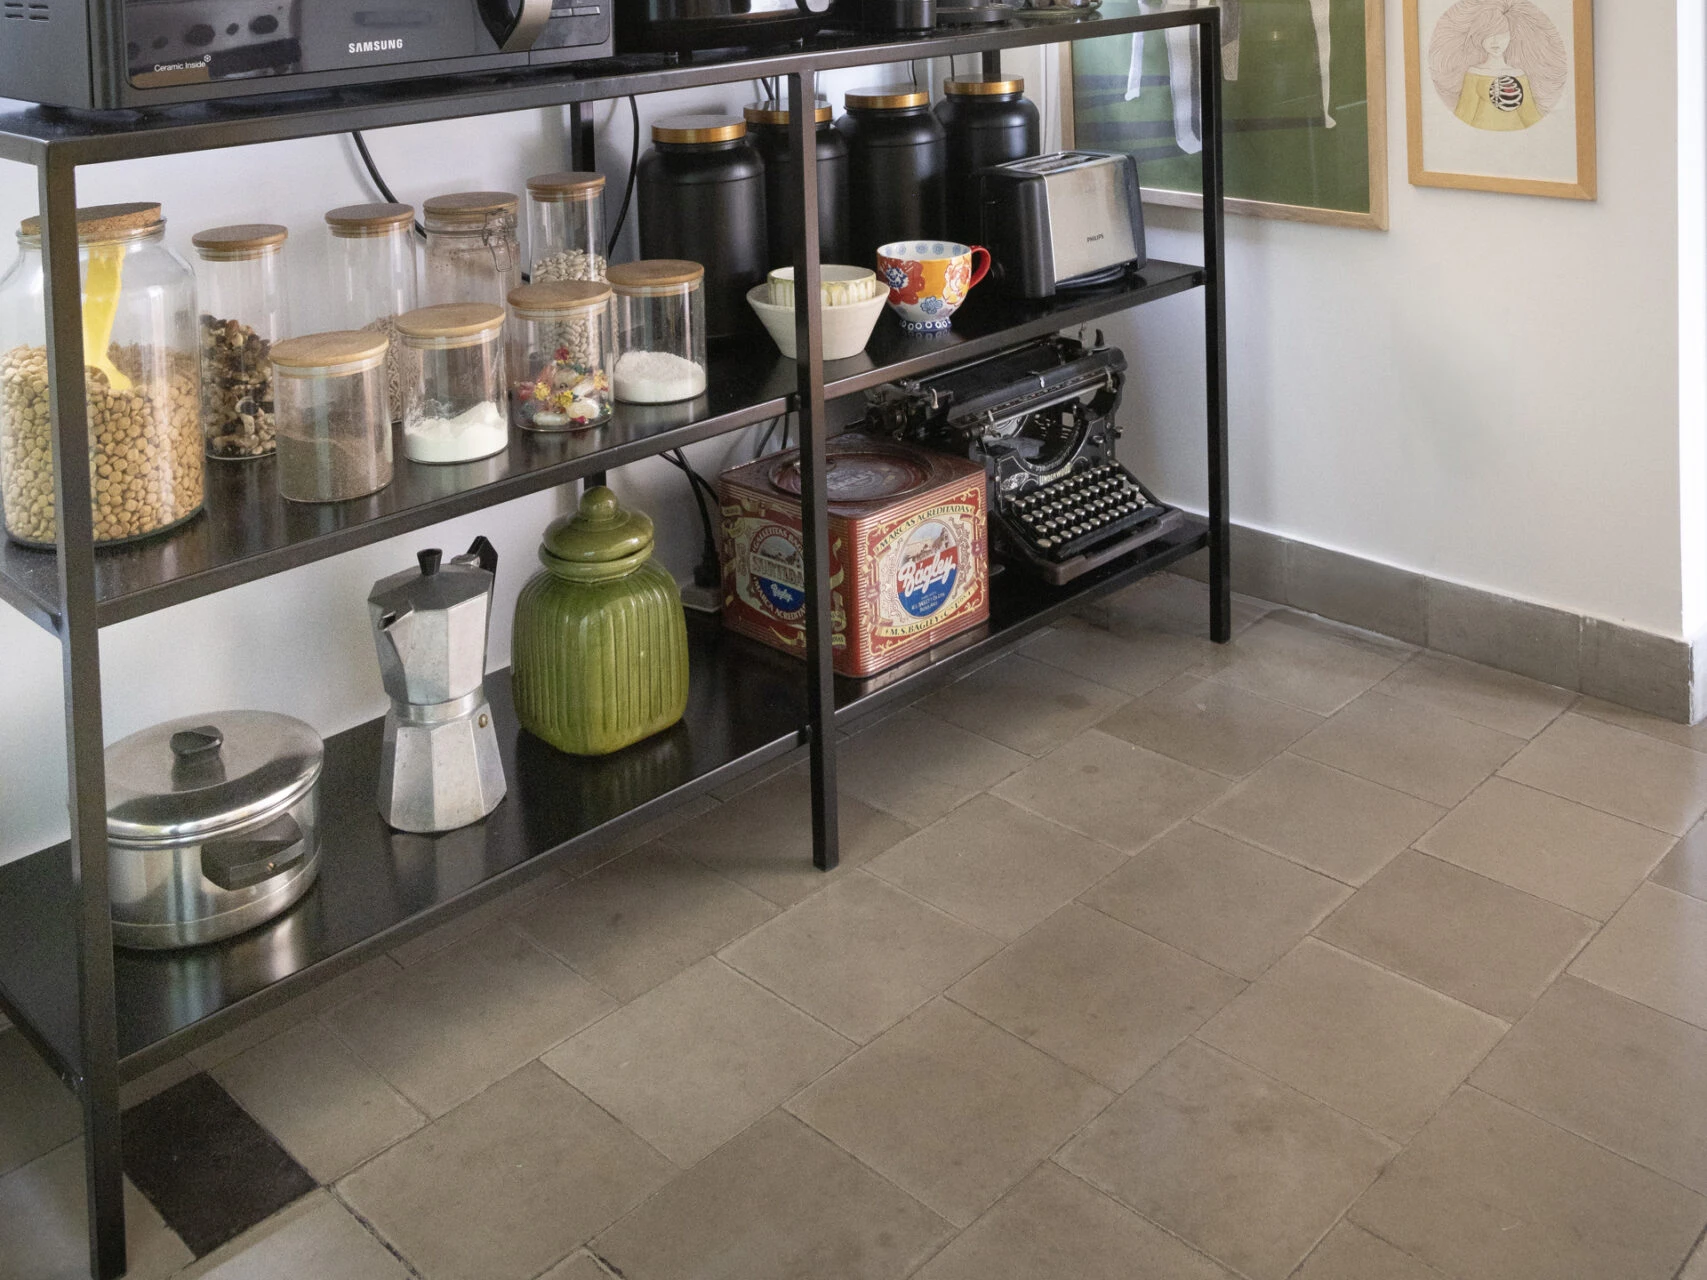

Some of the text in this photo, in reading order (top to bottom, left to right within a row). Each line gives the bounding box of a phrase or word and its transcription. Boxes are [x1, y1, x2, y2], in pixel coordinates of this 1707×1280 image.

[348, 38, 404, 54] SAMSUNG
[153, 60, 207, 73] Ceramic Inside
[1087, 233, 1104, 242] PHILIPS
[879, 505, 970, 549] MARCAS ACREDITADAS
